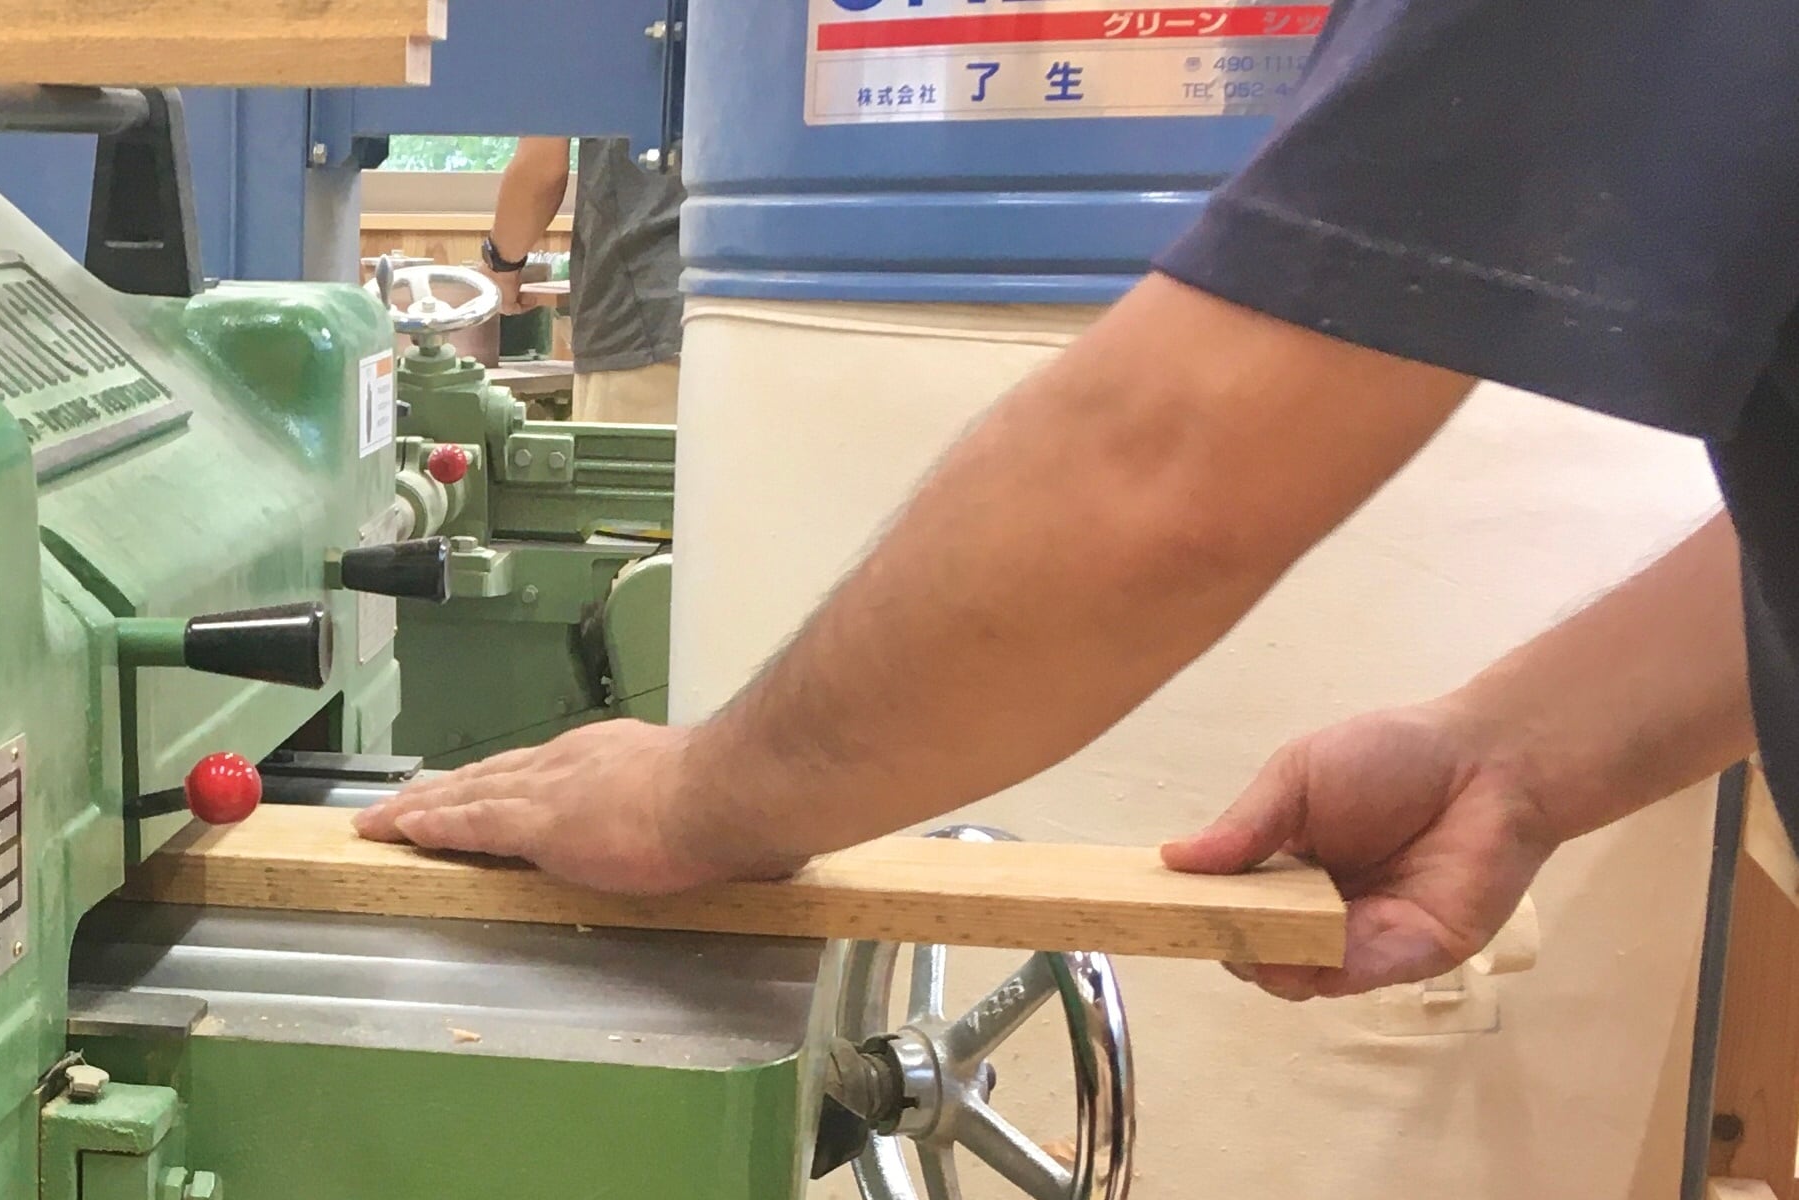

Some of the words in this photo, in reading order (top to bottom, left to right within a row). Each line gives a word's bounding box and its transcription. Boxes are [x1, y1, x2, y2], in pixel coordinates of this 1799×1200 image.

[1103, 12, 1228, 38] グリーン
[1262, 10, 1322, 36] シッ
[857, 84, 938, 107] 株式会社
